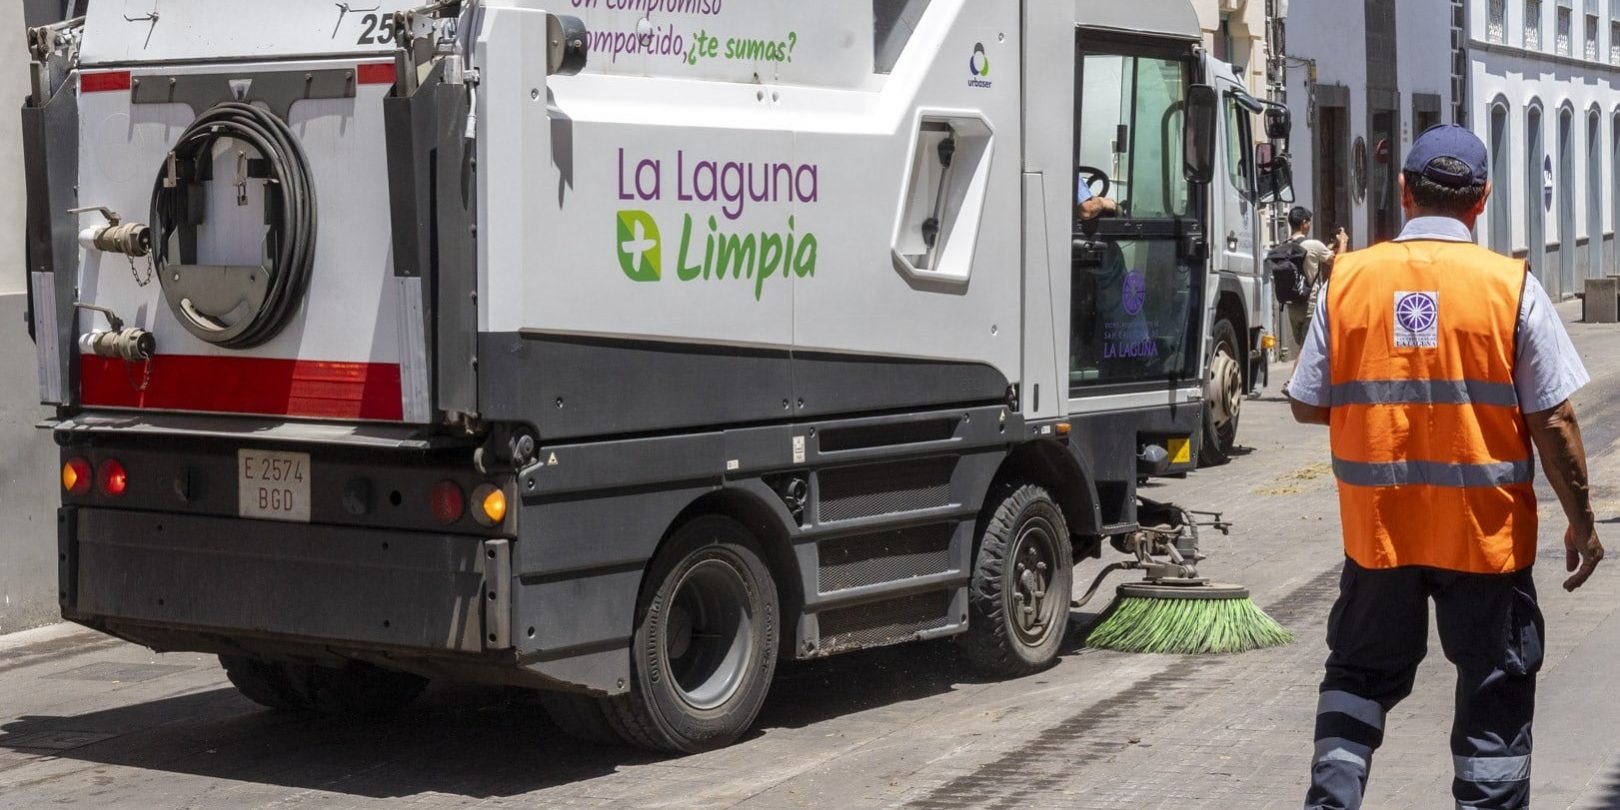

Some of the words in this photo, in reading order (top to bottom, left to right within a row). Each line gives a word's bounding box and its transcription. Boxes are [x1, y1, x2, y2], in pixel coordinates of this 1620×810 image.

[586, 23, 687, 64] ompartido,
[724, 31, 797, 63] sumas?
[967, 77, 992, 88] urbaser
[618, 147, 661, 201] La
[677, 149, 818, 220] Laguna
[676, 212, 818, 302] Limpia
[1104, 343, 1116, 358] LA
[1119, 342, 1158, 357] LAGUNA
[245, 456, 254, 480] E
[261, 457, 304, 483] 2574
[259, 486, 293, 512] BGD
